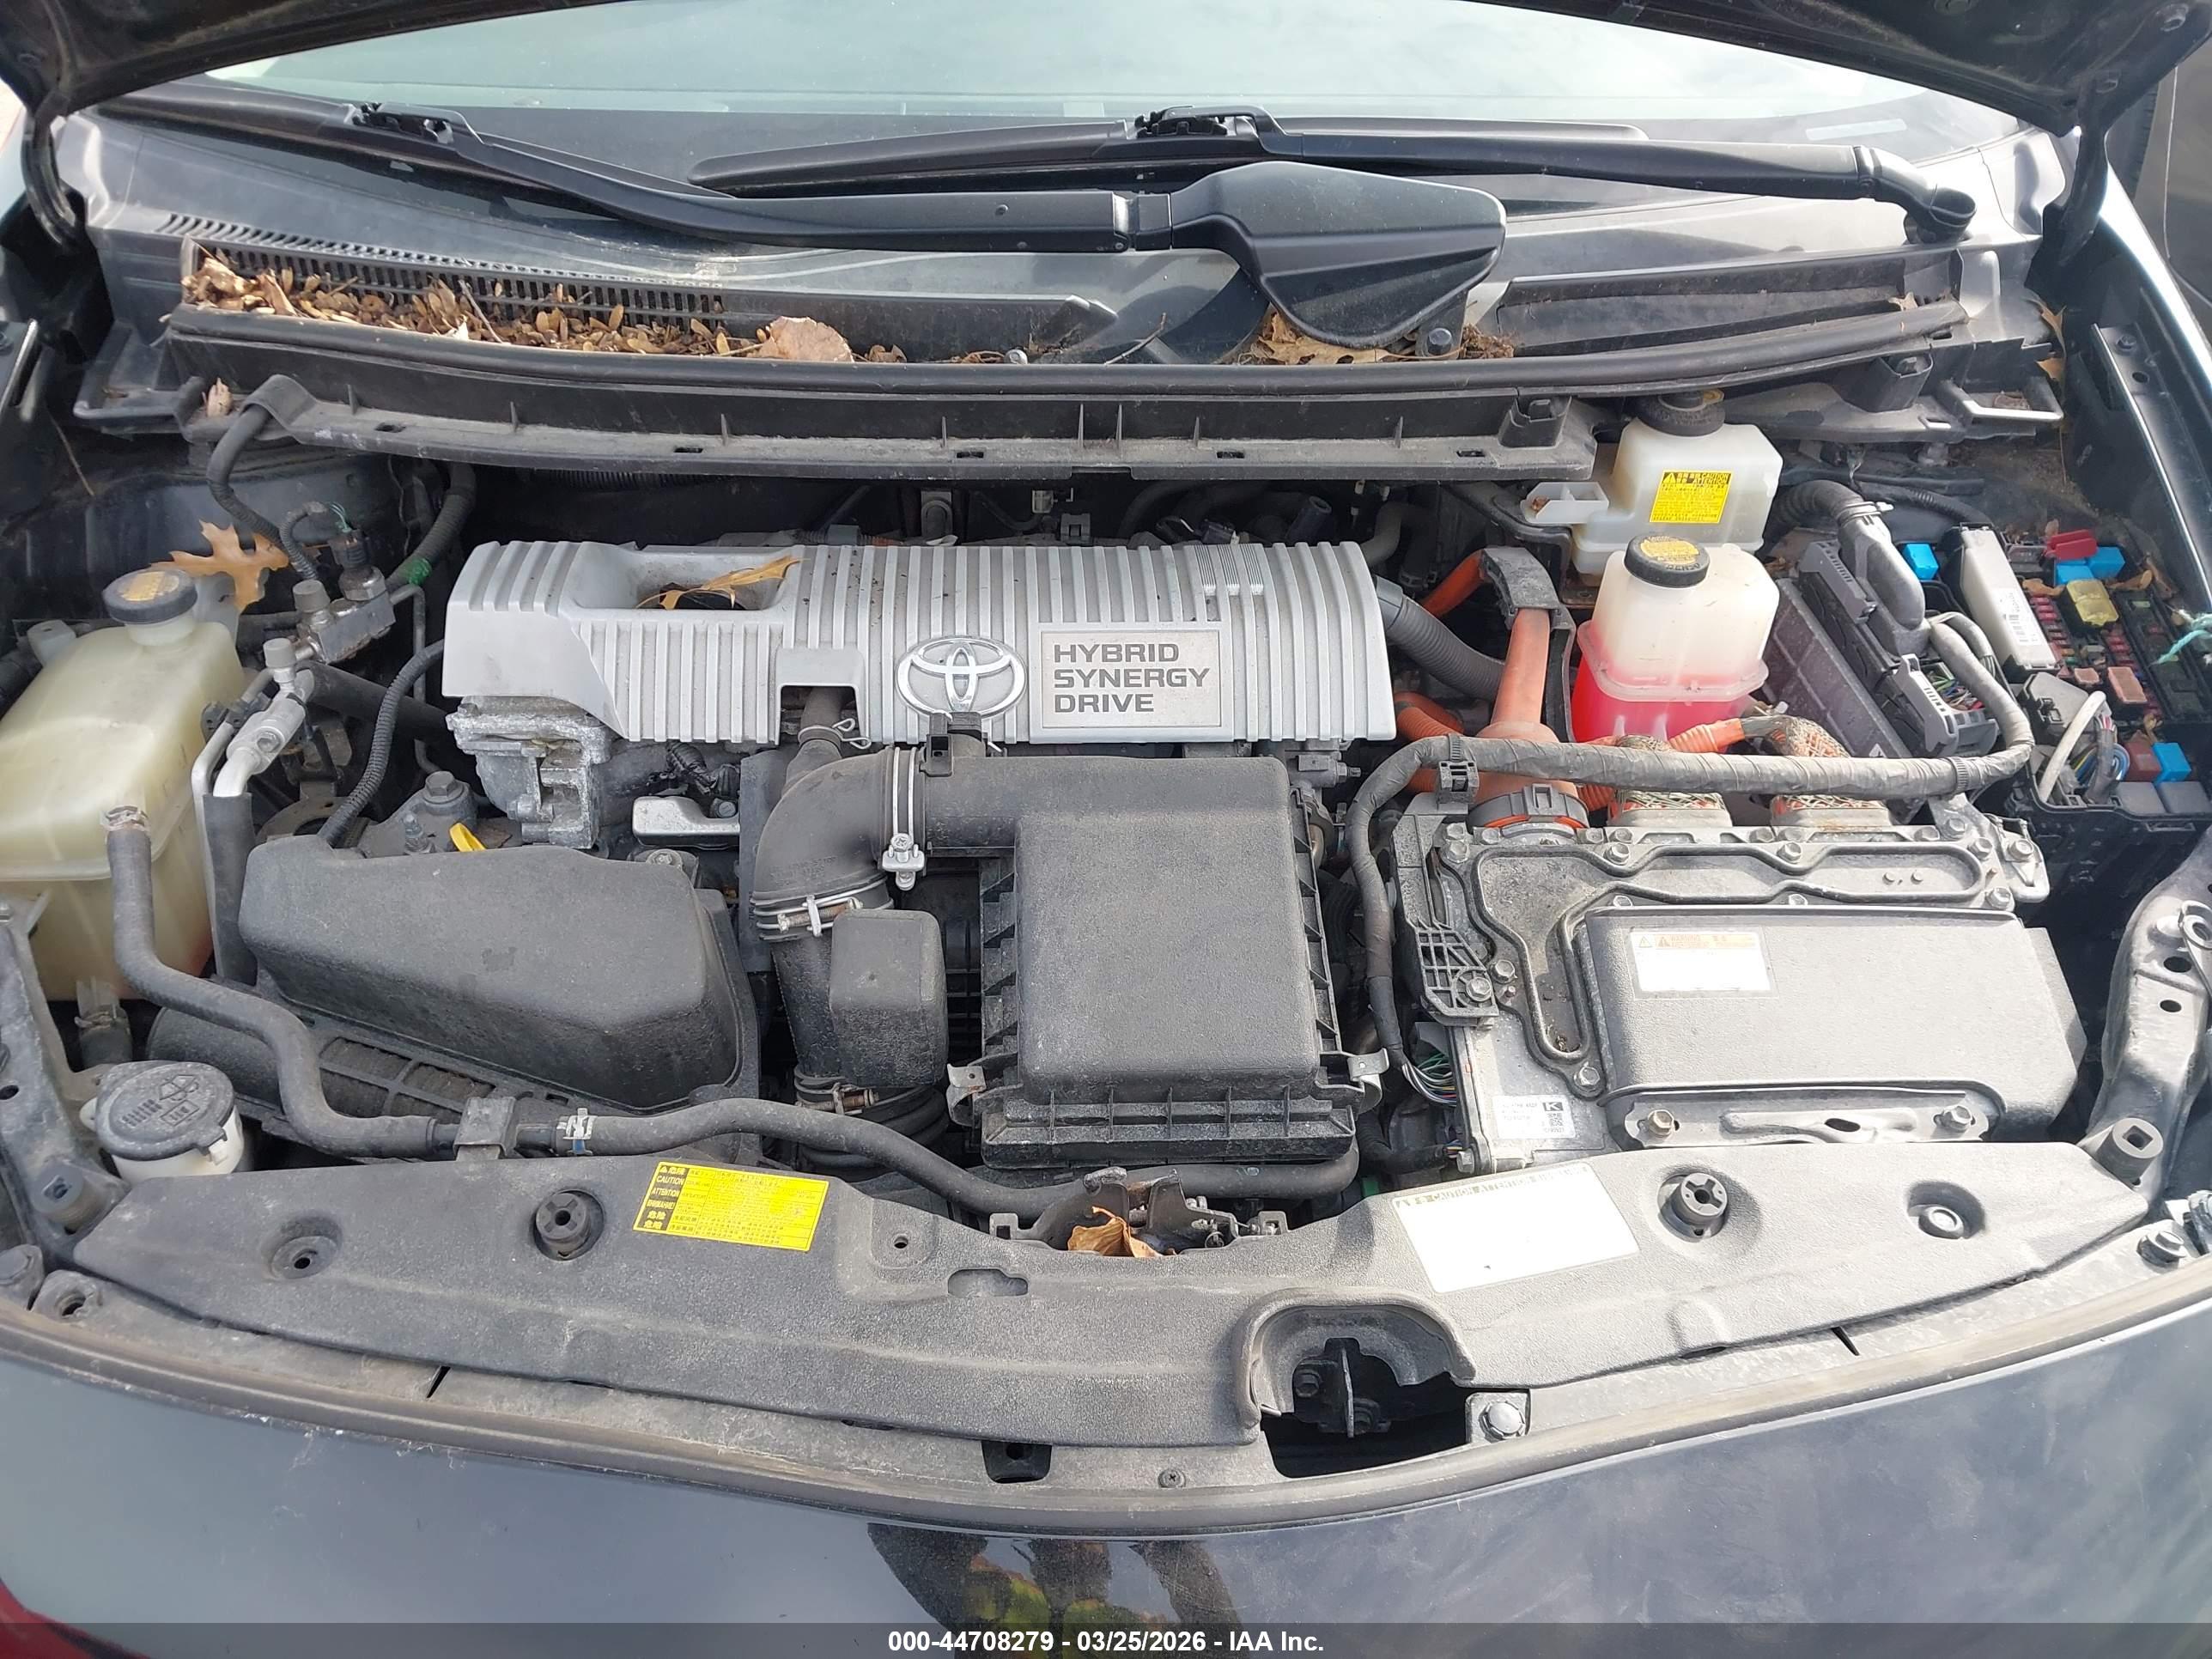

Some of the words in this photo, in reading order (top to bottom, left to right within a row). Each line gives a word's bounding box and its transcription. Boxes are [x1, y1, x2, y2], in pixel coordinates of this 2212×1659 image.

[1054, 643, 1180, 663] HYBRID
[1054, 668, 1210, 688] SYNERGY
[1054, 693, 1154, 713] DRIVE
[657, 1175, 685, 1185] CAUTION
[651, 1188, 680, 1197] ATTENTION
[1432, 1186, 1474, 1201] CAUTION
